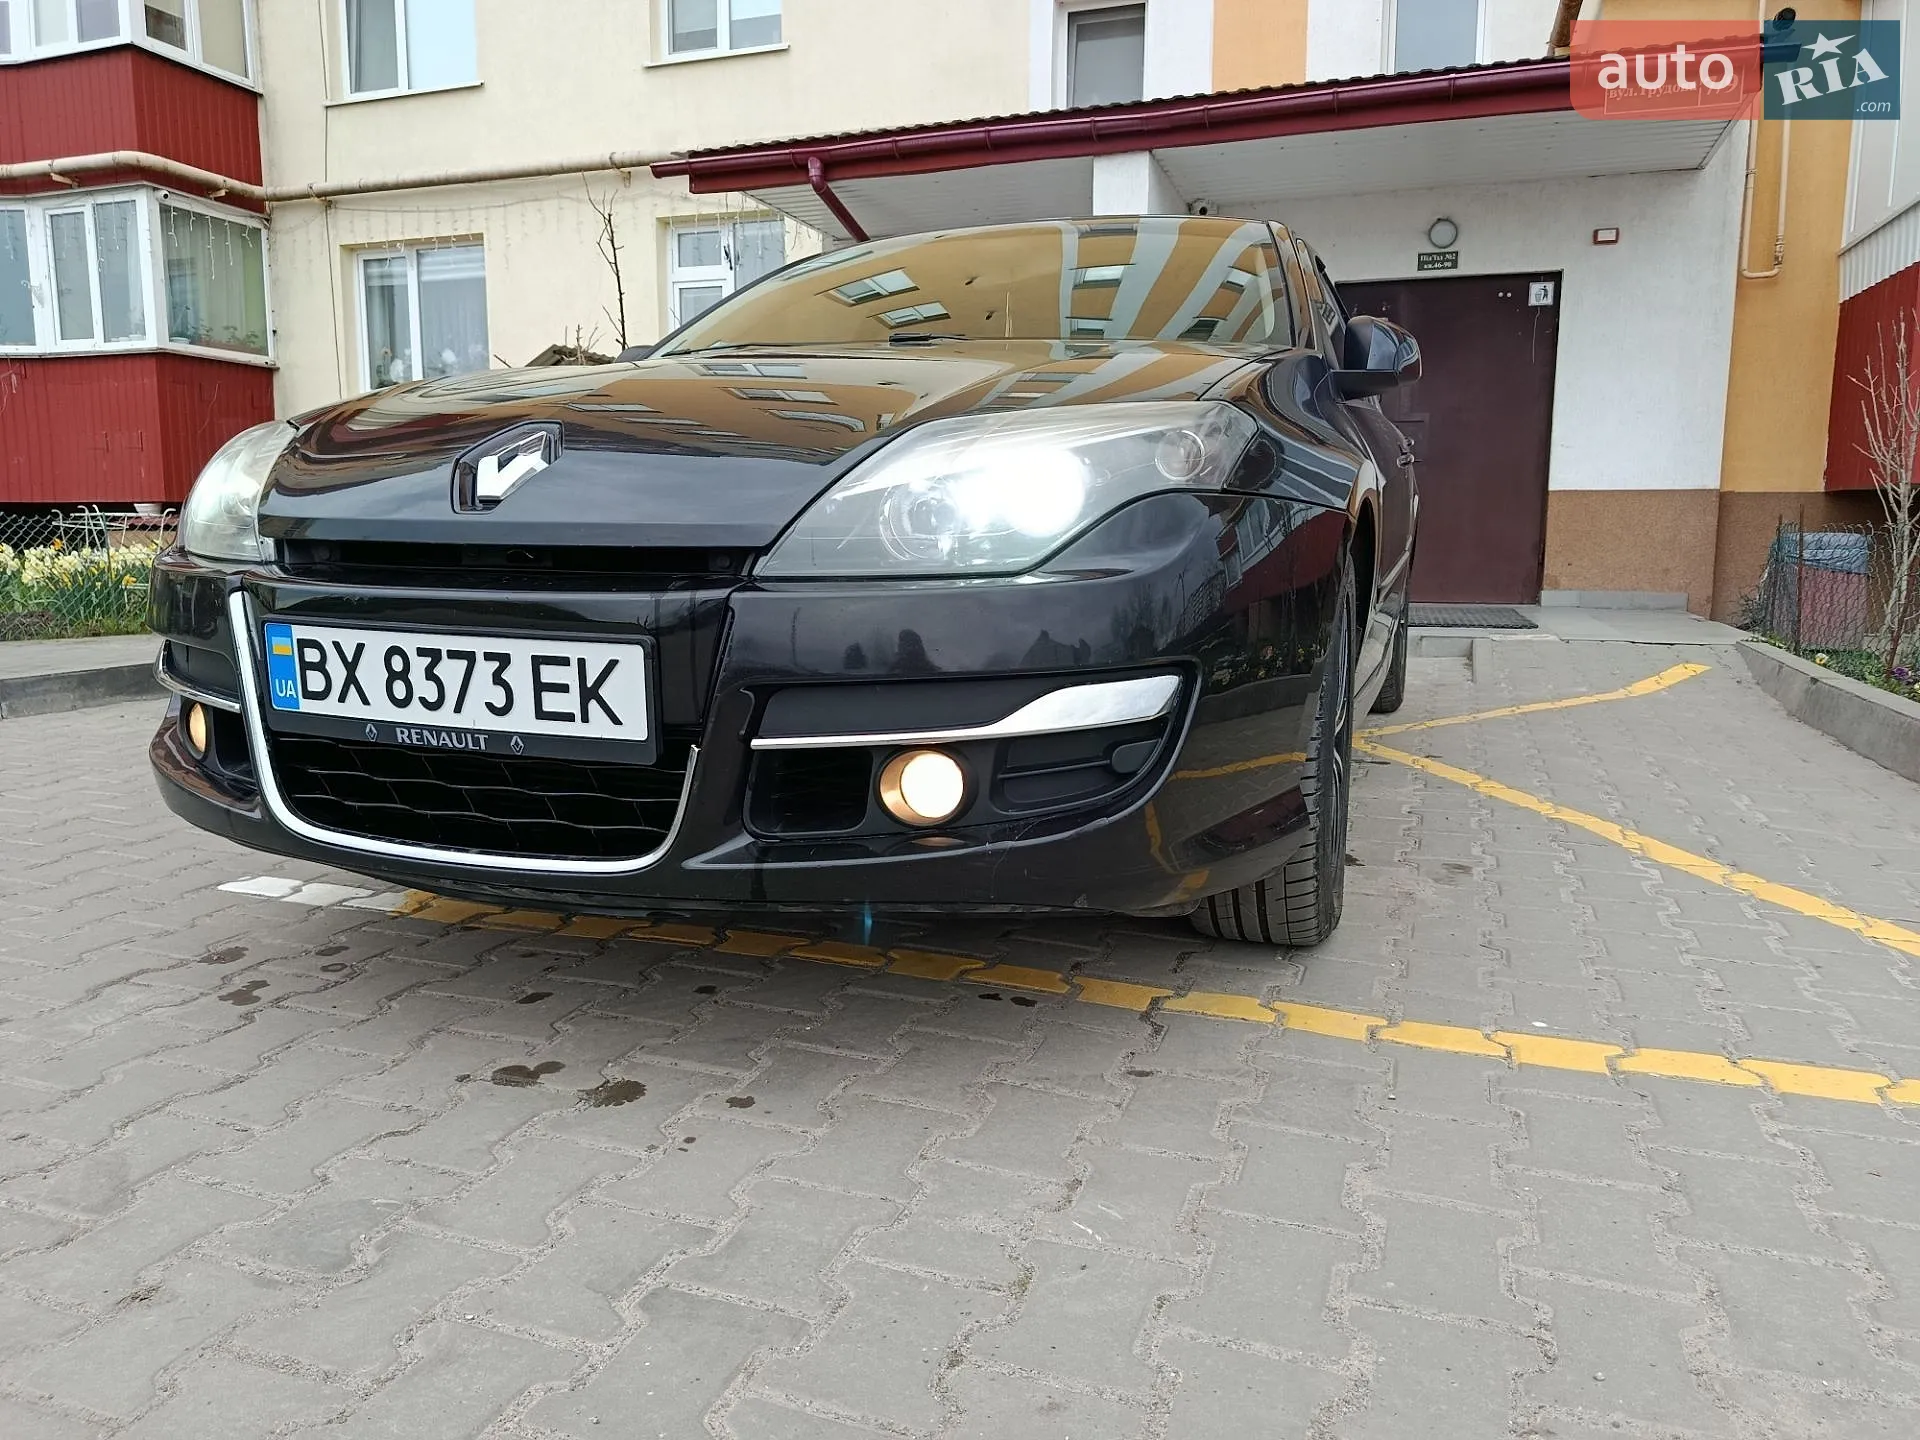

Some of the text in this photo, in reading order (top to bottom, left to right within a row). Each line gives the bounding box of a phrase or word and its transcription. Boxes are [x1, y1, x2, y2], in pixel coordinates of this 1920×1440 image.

[1640, 82, 1697, 98] Трудо
[275, 679, 297, 698] UA
[297, 637, 623, 726] BX 8373 EK
[395, 727, 489, 751] RENAULT
